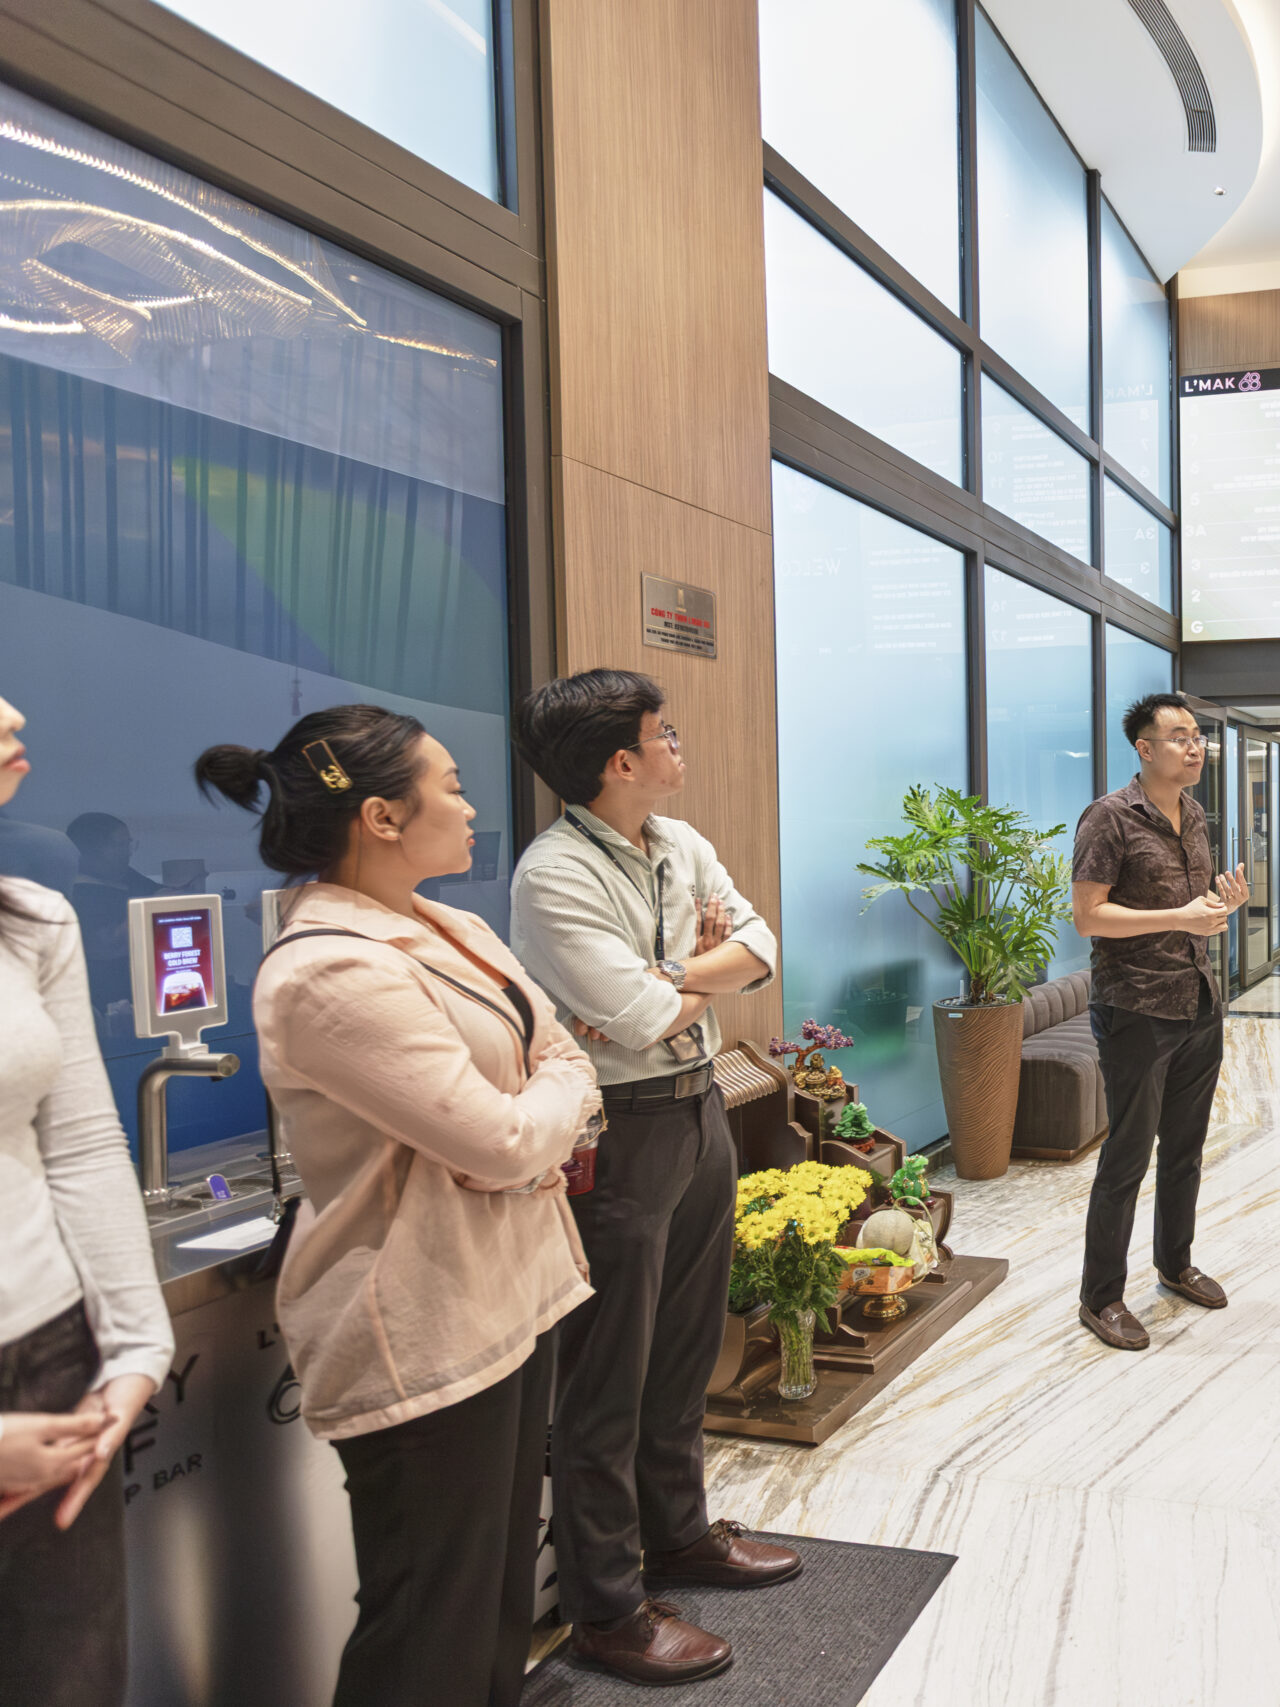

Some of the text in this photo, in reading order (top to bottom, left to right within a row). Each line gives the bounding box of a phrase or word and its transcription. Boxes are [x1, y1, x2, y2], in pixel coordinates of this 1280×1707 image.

[1185, 372, 1262, 394] L'MAK 68
[1191, 589, 1201, 602] 2
[1190, 620, 1204, 634] G
[153, 1453, 203, 1491] BAR
